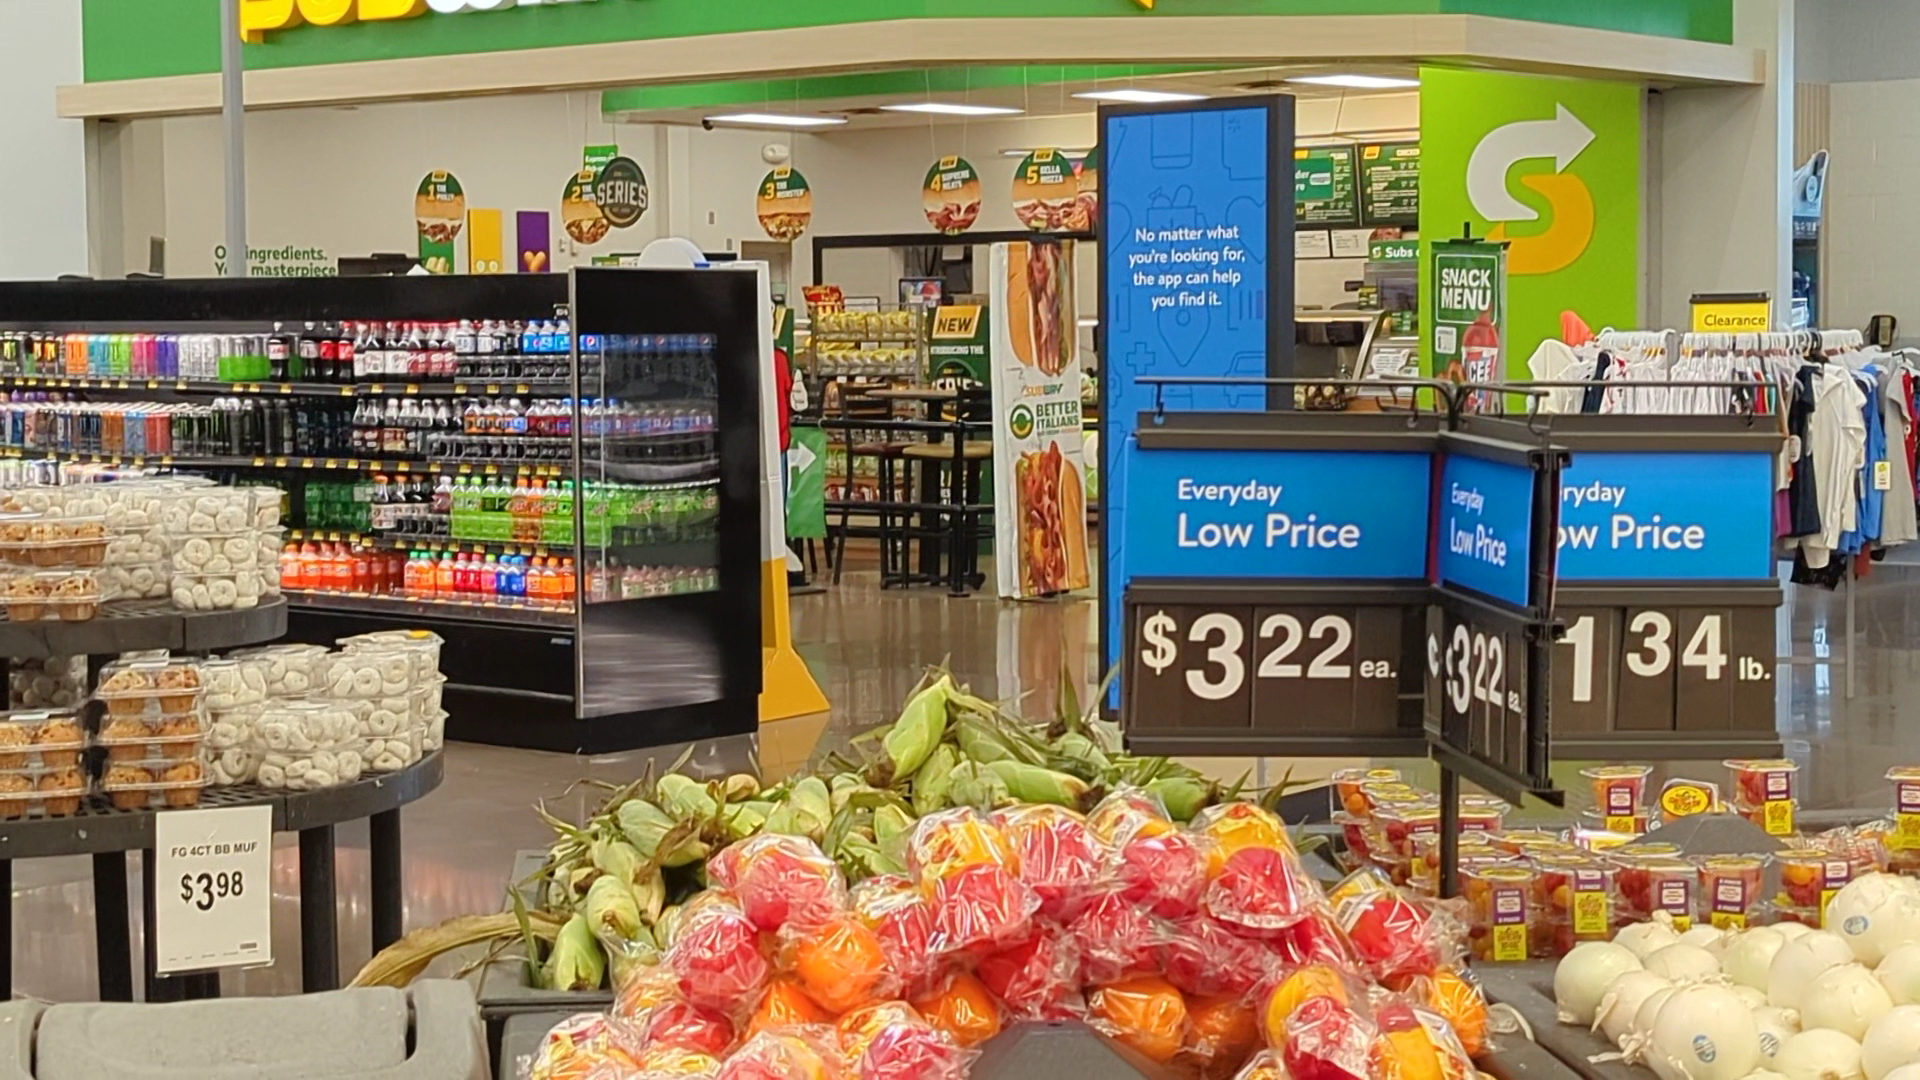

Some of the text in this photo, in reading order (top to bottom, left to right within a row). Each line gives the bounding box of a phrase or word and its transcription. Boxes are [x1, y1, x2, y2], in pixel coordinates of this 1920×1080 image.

[931, 173, 941, 192] 4
[1026, 165, 1039, 185] 5
[427, 184, 435, 201] 1
[571, 185, 581, 203] 2
[597, 180, 647, 209] SERIES
[764, 182, 775, 200] 3
[1135, 224, 1239, 243] No matter what
[246, 245, 328, 264] ingredients.
[1128, 245, 1246, 269] you're looking for,
[1384, 246, 1414, 258] Subs
[251, 262, 337, 278] masterpiece
[1133, 268, 1241, 289] the app can help
[1441, 268, 1491, 288] SNACK
[1151, 290, 1222, 312] you find it.
[1441, 287, 1491, 311] MENU
[937, 317, 972, 333] NEW
[1704, 313, 1766, 327] Clearance
[1036, 400, 1078, 417] BETTER
[1036, 415, 1079, 430] ITALIANS
[1177, 478, 1283, 507] Everyday
[1451, 481, 1485, 516] Everyday
[1560, 480, 1626, 508] ryday
[1177, 512, 1361, 548] Low Price
[1557, 522, 1599, 550] ow
[1611, 514, 1705, 550] Price
[1450, 517, 1507, 567] Low Price
[1359, 659, 1398, 679] ea.
[1738, 656, 1772, 681] lb.
[171, 842, 258, 858] FG 4CT BB MUF
